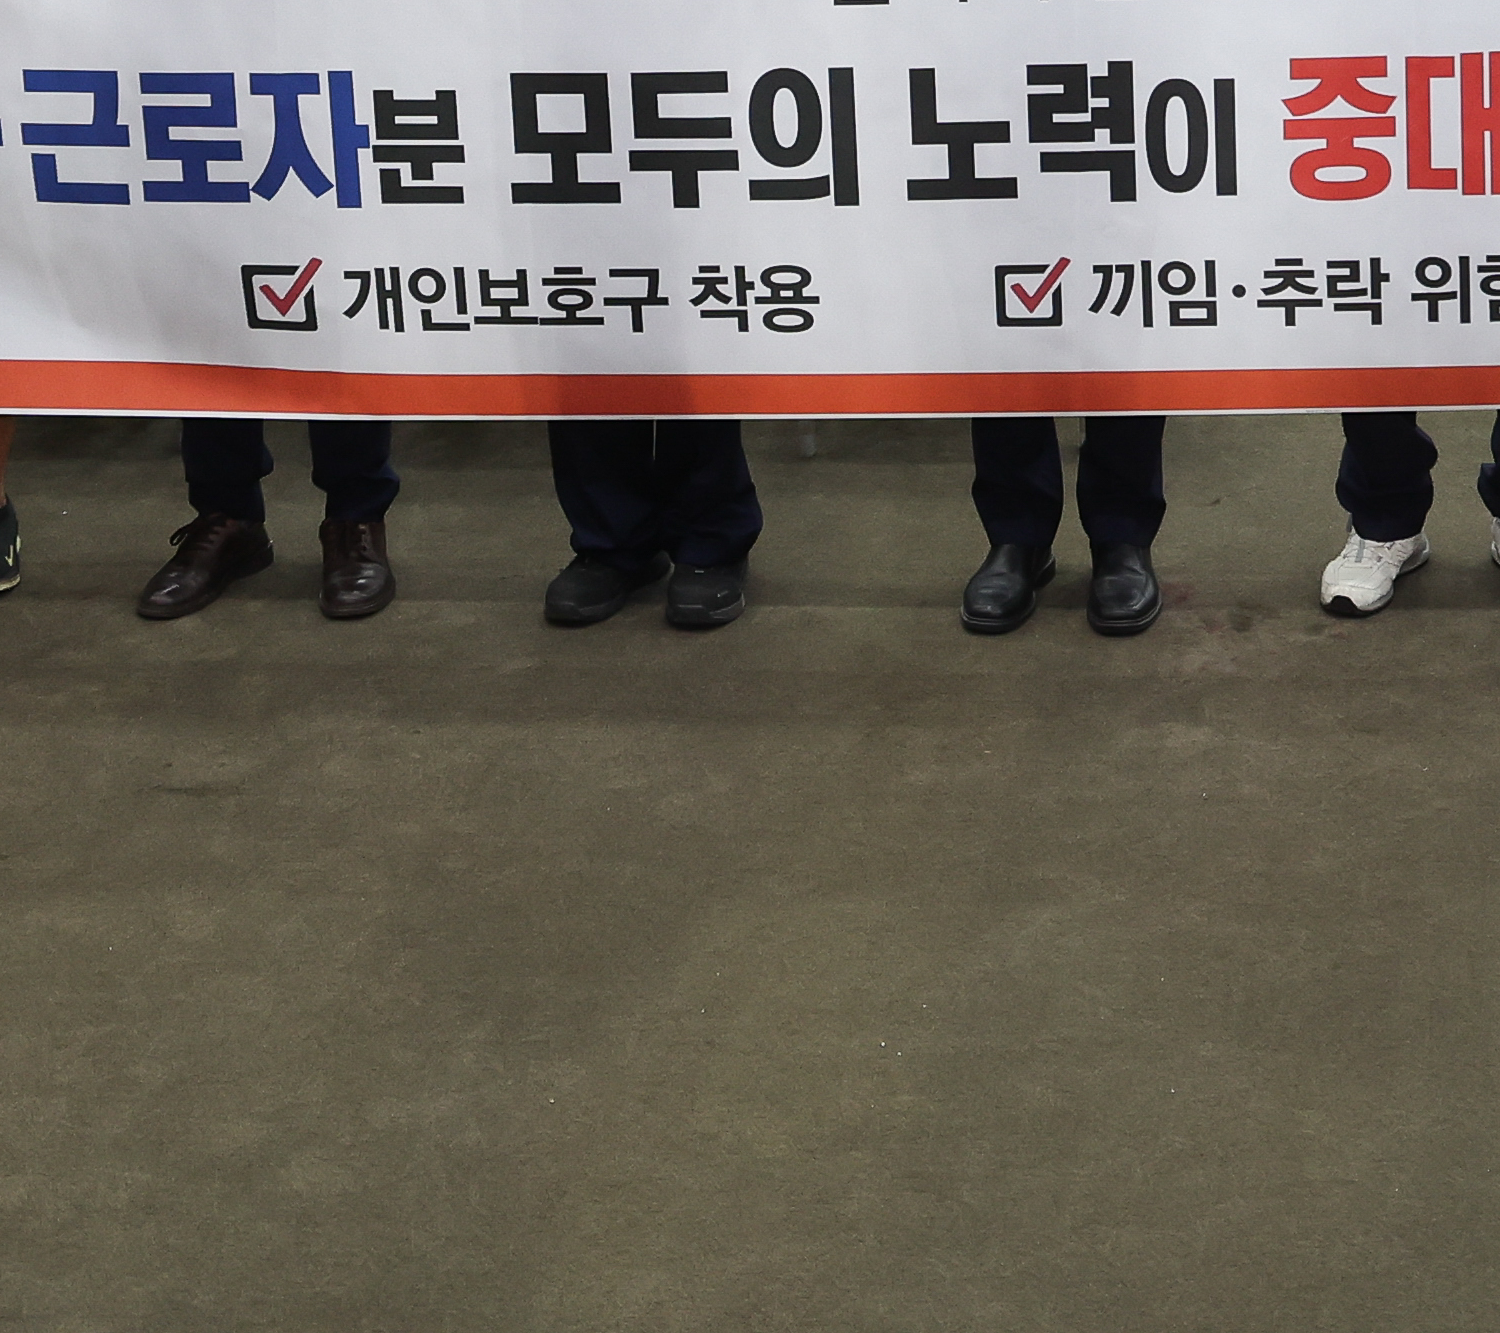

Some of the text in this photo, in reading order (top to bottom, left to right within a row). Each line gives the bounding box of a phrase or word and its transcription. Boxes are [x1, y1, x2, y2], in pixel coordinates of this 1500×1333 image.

[508, 65, 861, 210] 모두의
[905, 59, 1238, 203] 노력이
[341, 263, 671, 335] 개인보호구
[688, 263, 820, 333] 착용
[1089, 255, 1391, 329] 끼임·추락
